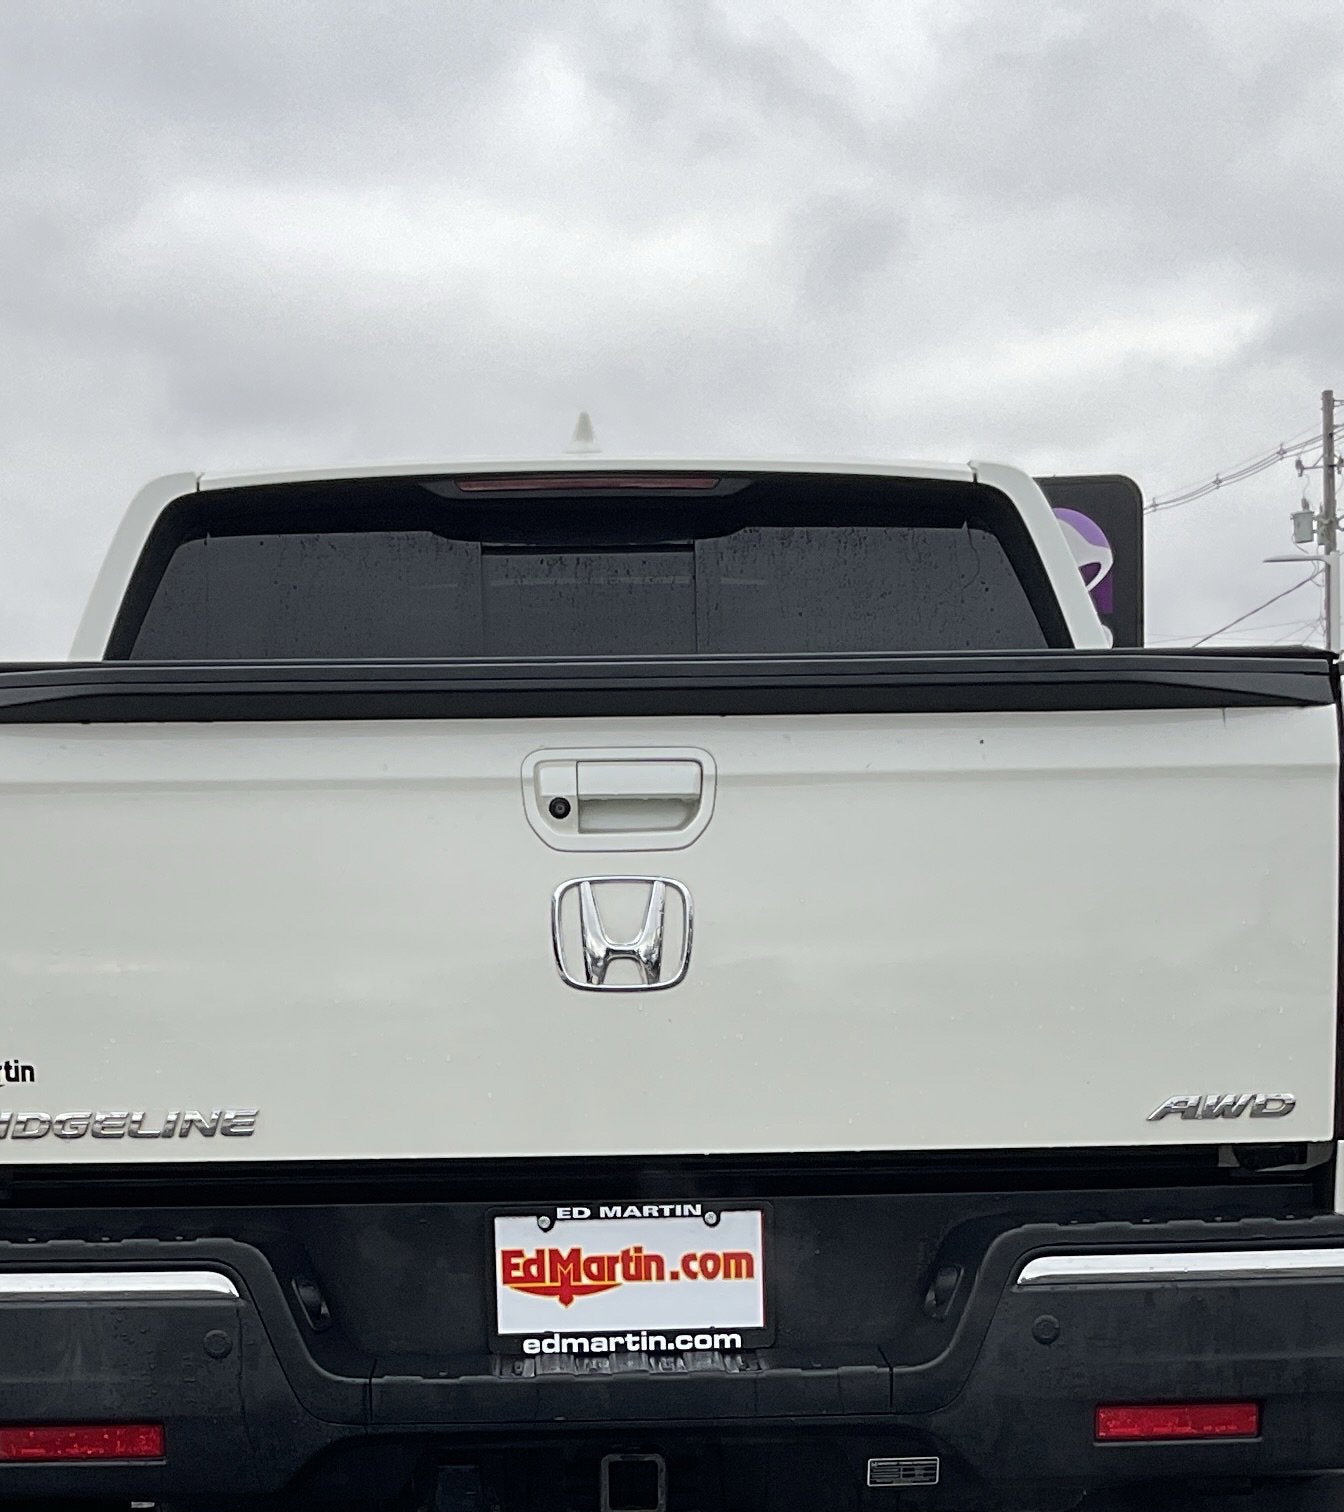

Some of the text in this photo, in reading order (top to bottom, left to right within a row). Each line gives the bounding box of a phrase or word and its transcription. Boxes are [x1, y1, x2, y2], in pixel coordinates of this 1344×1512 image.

[1145, 1093, 1297, 1121] AWD
[556, 1203, 702, 1219] ED MARTIN
[522, 1331, 742, 1354] edmartin.com
